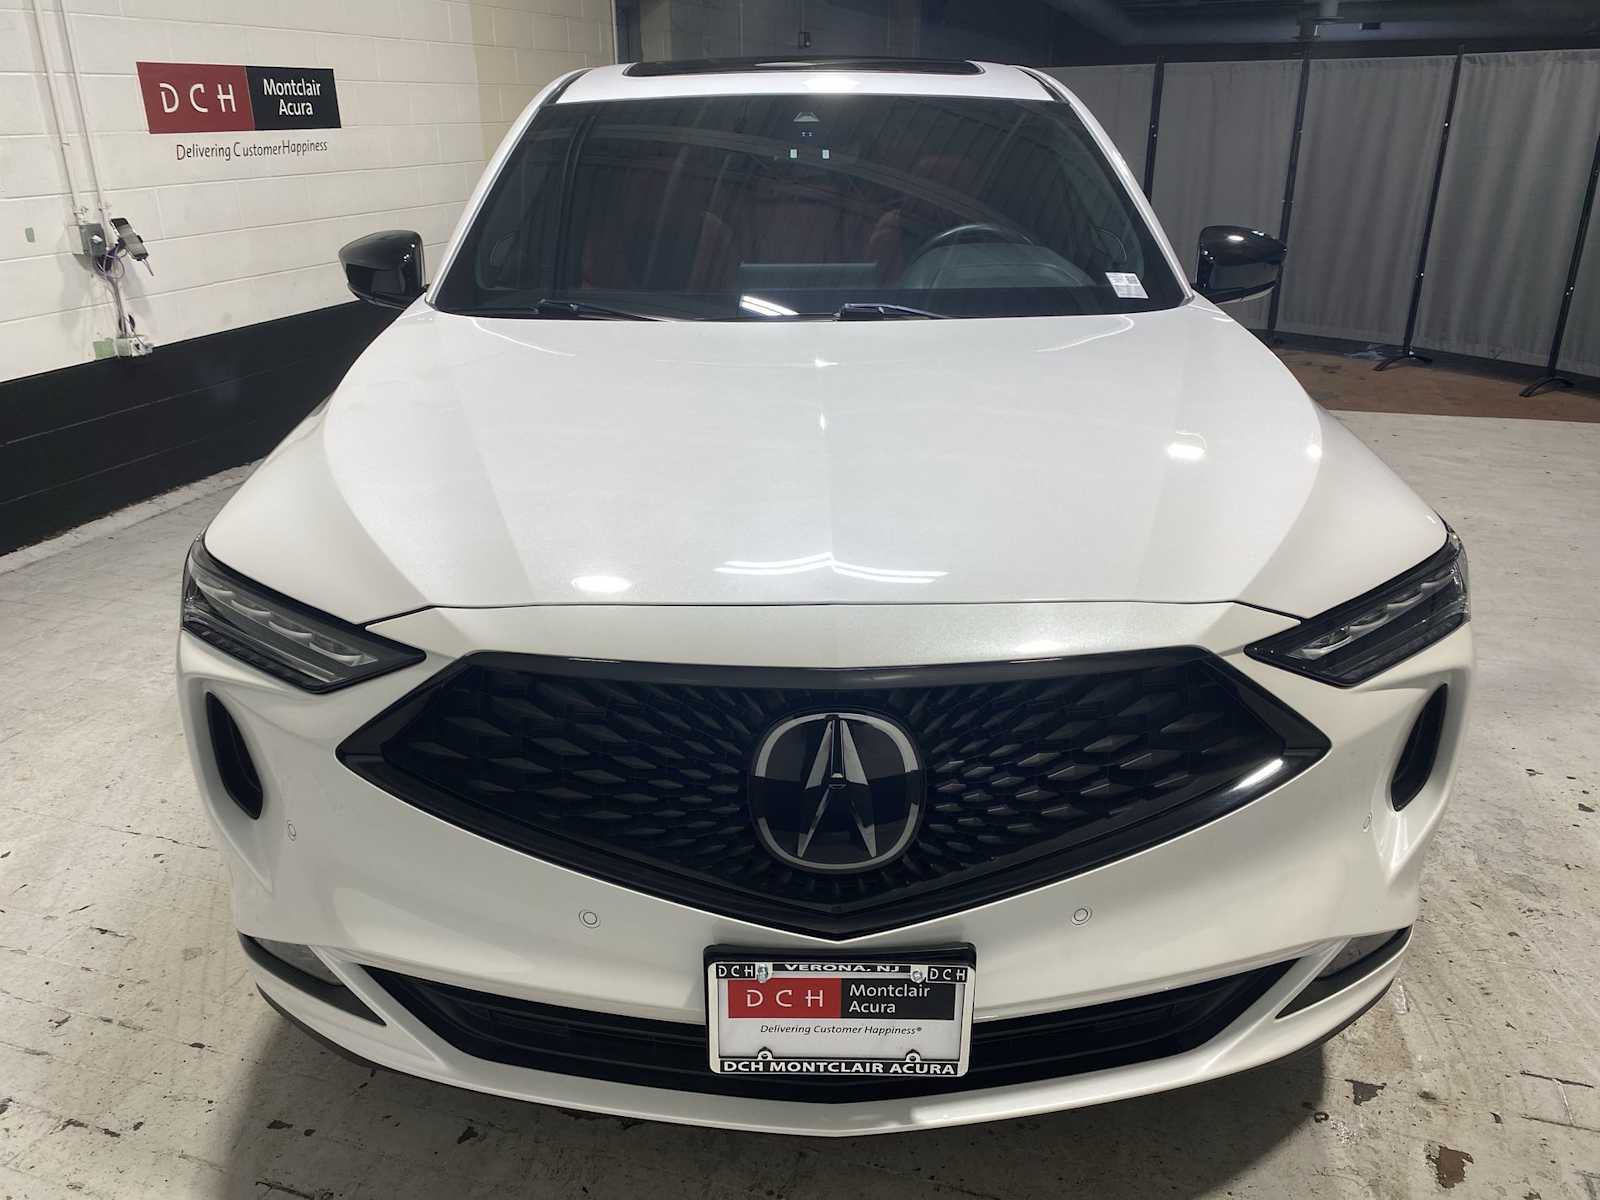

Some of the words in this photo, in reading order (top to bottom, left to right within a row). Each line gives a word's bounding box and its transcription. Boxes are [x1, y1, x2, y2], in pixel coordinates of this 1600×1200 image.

[263, 78, 321, 97] Montclair
[159, 82, 236, 113] DCH
[278, 99, 313, 116] Acura
[176, 143, 231, 161] Delivering
[718, 965, 754, 977] DCH
[929, 967, 966, 981] DCH
[849, 984, 930, 997] Montclair
[746, 989, 823, 1007] DCH
[849, 1001, 896, 1014] Acura
[760, 1024, 811, 1035] Delivering
[813, 1025, 862, 1034] Customer
[723, 1061, 764, 1073] DCH
[770, 1061, 884, 1073] MONTCLAIR
[889, 1063, 955, 1075] ACURA
